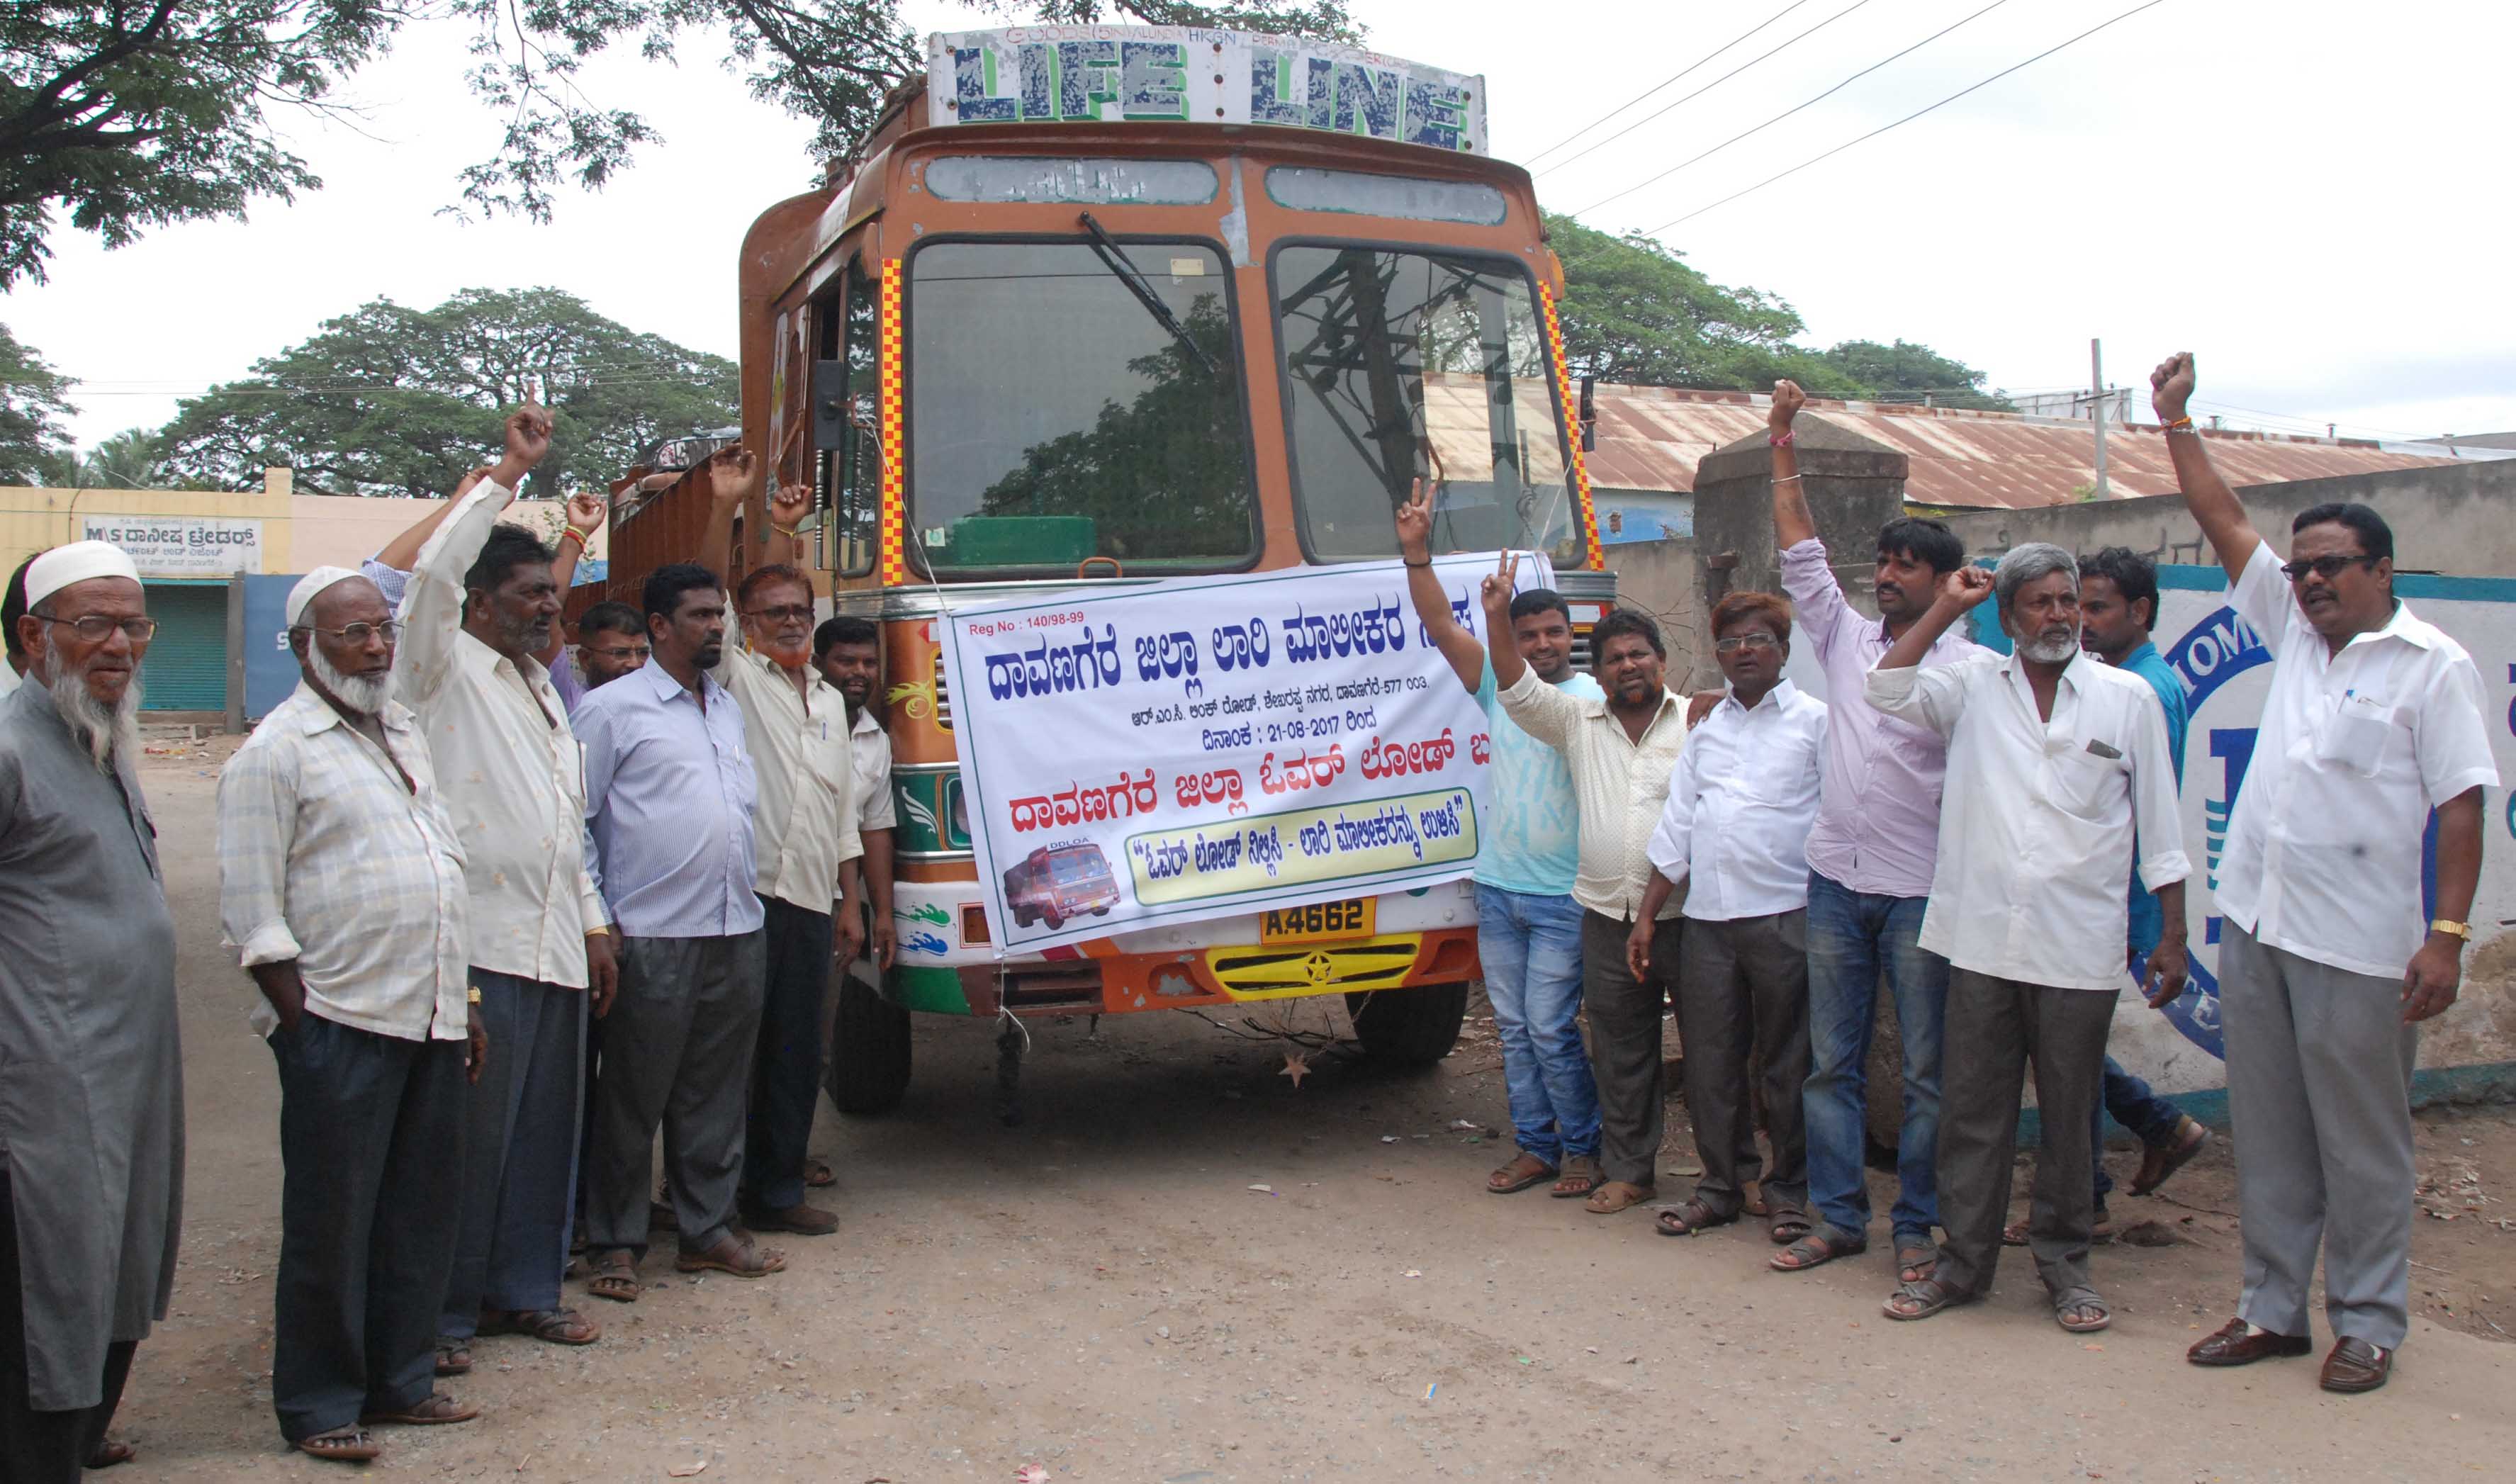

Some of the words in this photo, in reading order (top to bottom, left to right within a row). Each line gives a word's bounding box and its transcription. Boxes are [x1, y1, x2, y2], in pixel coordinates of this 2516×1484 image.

[1189, 28, 1236, 45] HKGN
[954, 40, 1189, 123] LIFE
[1251, 51, 1468, 150] LINE
[189, 527, 255, 547] ಟ್ರೇಡರ್ಸ್
[969, 624, 994, 636] Reg
[997, 620, 1015, 632] No
[1027, 611, 1084, 629] 140/98-99
[984, 623, 1121, 701] ದಾವಣಗೆರೆ
[1135, 631, 1203, 699] ಜಿಲ್ಲಾ
[1212, 617, 1271, 672] ಲಾರಿ
[1281, 590, 1405, 664] ಮಾಲೀಕರ
[1189, 698, 1218, 719] ಲಿಂಕ್
[1222, 694, 1261, 714] ರೋಡ್,
[1306, 683, 1333, 704] ನಗರ,
[1202, 721, 1252, 751] ದಿನಾಂಕ
[1267, 714, 1340, 743] 21-08-2017
[1346, 705, 1377, 732] ರಿಂದ
[1009, 768, 1158, 833] ದಾವಣಗೆರೆ
[1174, 768, 1249, 816] ಜಿಲ್ಲಾ
[1259, 742, 1346, 795] ಓವರ್
[1360, 727, 1455, 780] ಲೋಡ್
[1050, 837, 1090, 849] DDLOA
[1194, 831, 1241, 873] ಲೋಡ್
[1247, 825, 1283, 877] ನಿಲ್ಲಿಸಿ
[1299, 819, 1331, 857] ಲಾರಿ
[1334, 804, 1423, 862] ಮಾಲೀಕರನ್ನು
